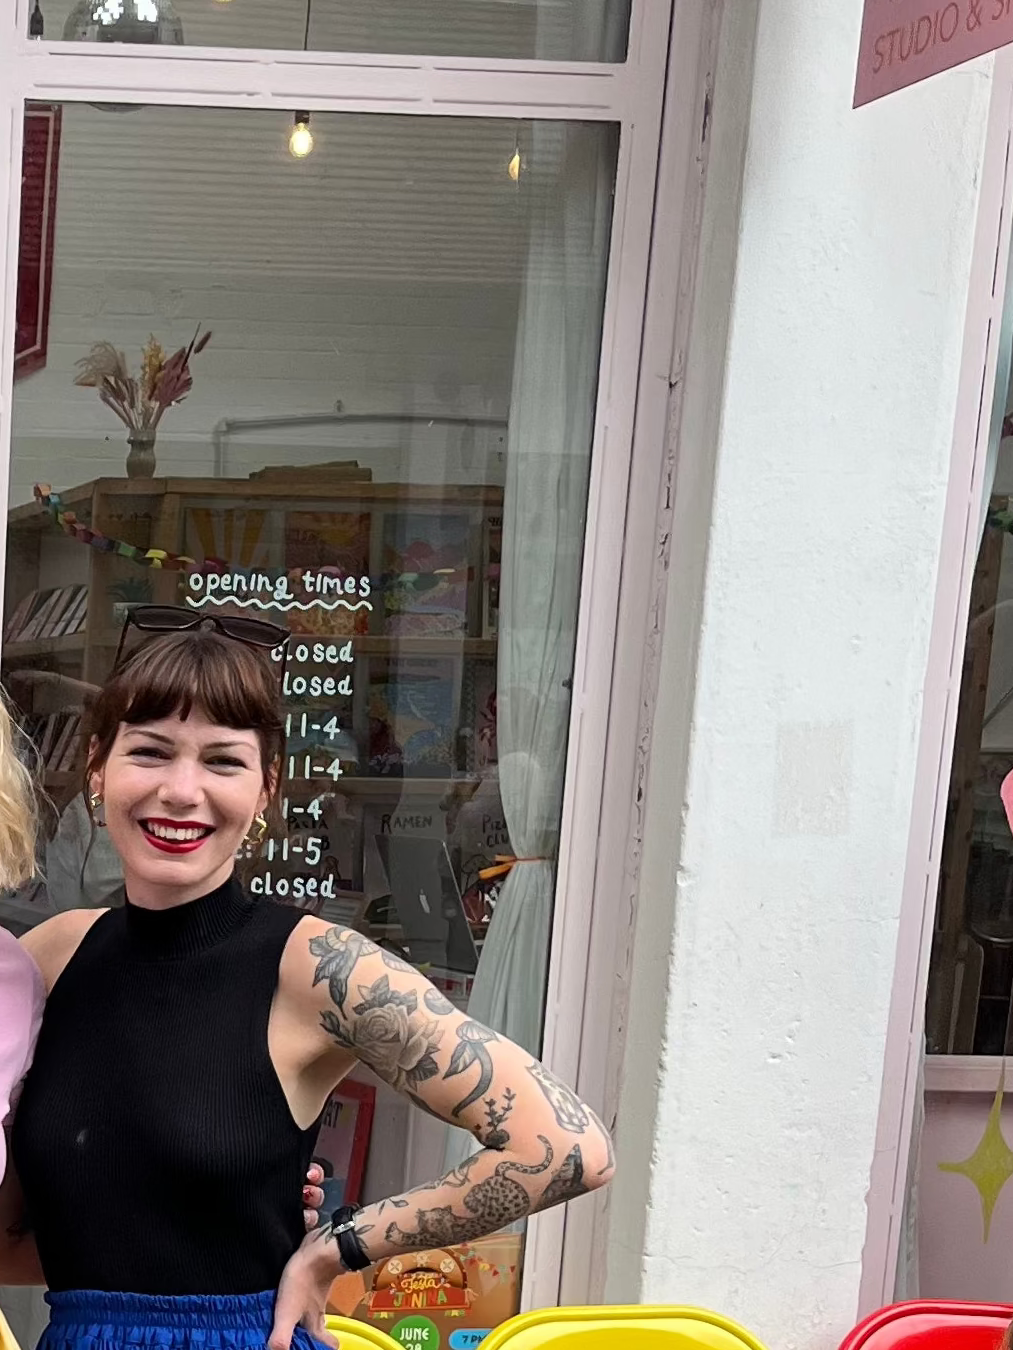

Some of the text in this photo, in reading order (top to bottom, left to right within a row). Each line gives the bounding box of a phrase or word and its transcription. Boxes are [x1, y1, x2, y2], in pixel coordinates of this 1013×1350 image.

[872, 2, 959, 74] STUDIO
[189, 569, 372, 600] opening times
[271, 640, 354, 664] cosed
[282, 671, 354, 697] losed
[285, 713, 341, 740] 11-4
[288, 755, 344, 781] 11-4
[282, 797, 323, 821] 1-4
[381, 814, 433, 835] RAMEN
[267, 837, 321, 866] 11-5
[250, 872, 337, 899] closed
[401, 1273, 441, 1294] Festa
[399, 1327, 429, 1341] JUNE
[462, 1334, 469, 1343] 7
